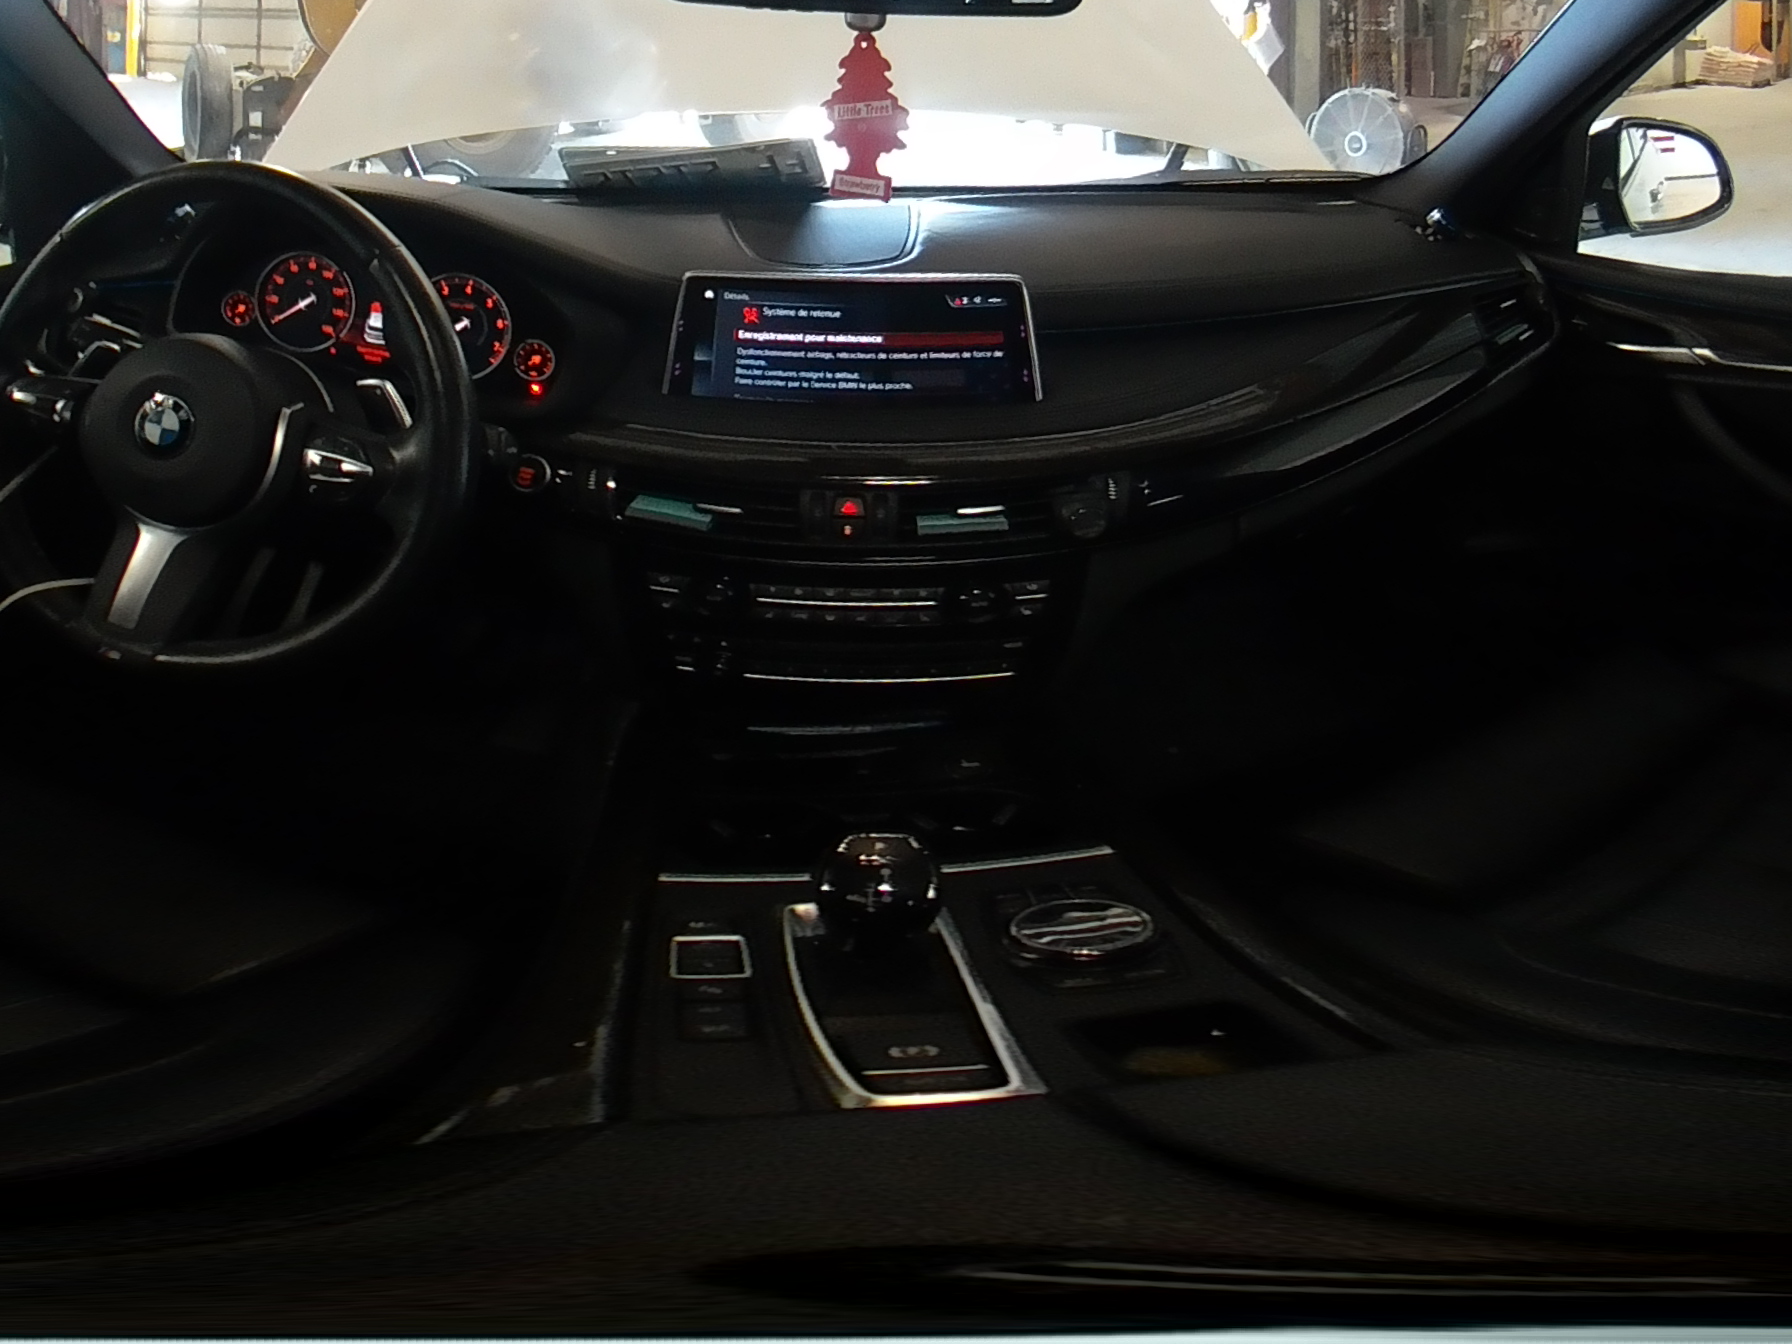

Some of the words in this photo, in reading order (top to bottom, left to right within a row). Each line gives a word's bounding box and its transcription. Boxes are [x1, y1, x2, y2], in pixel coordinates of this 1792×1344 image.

[762, 306, 796, 317] Système
[797, 308, 809, 317] de
[810, 309, 842, 319] retenue
[737, 329, 802, 342] Enregistrement
[804, 333, 825, 343] pour
